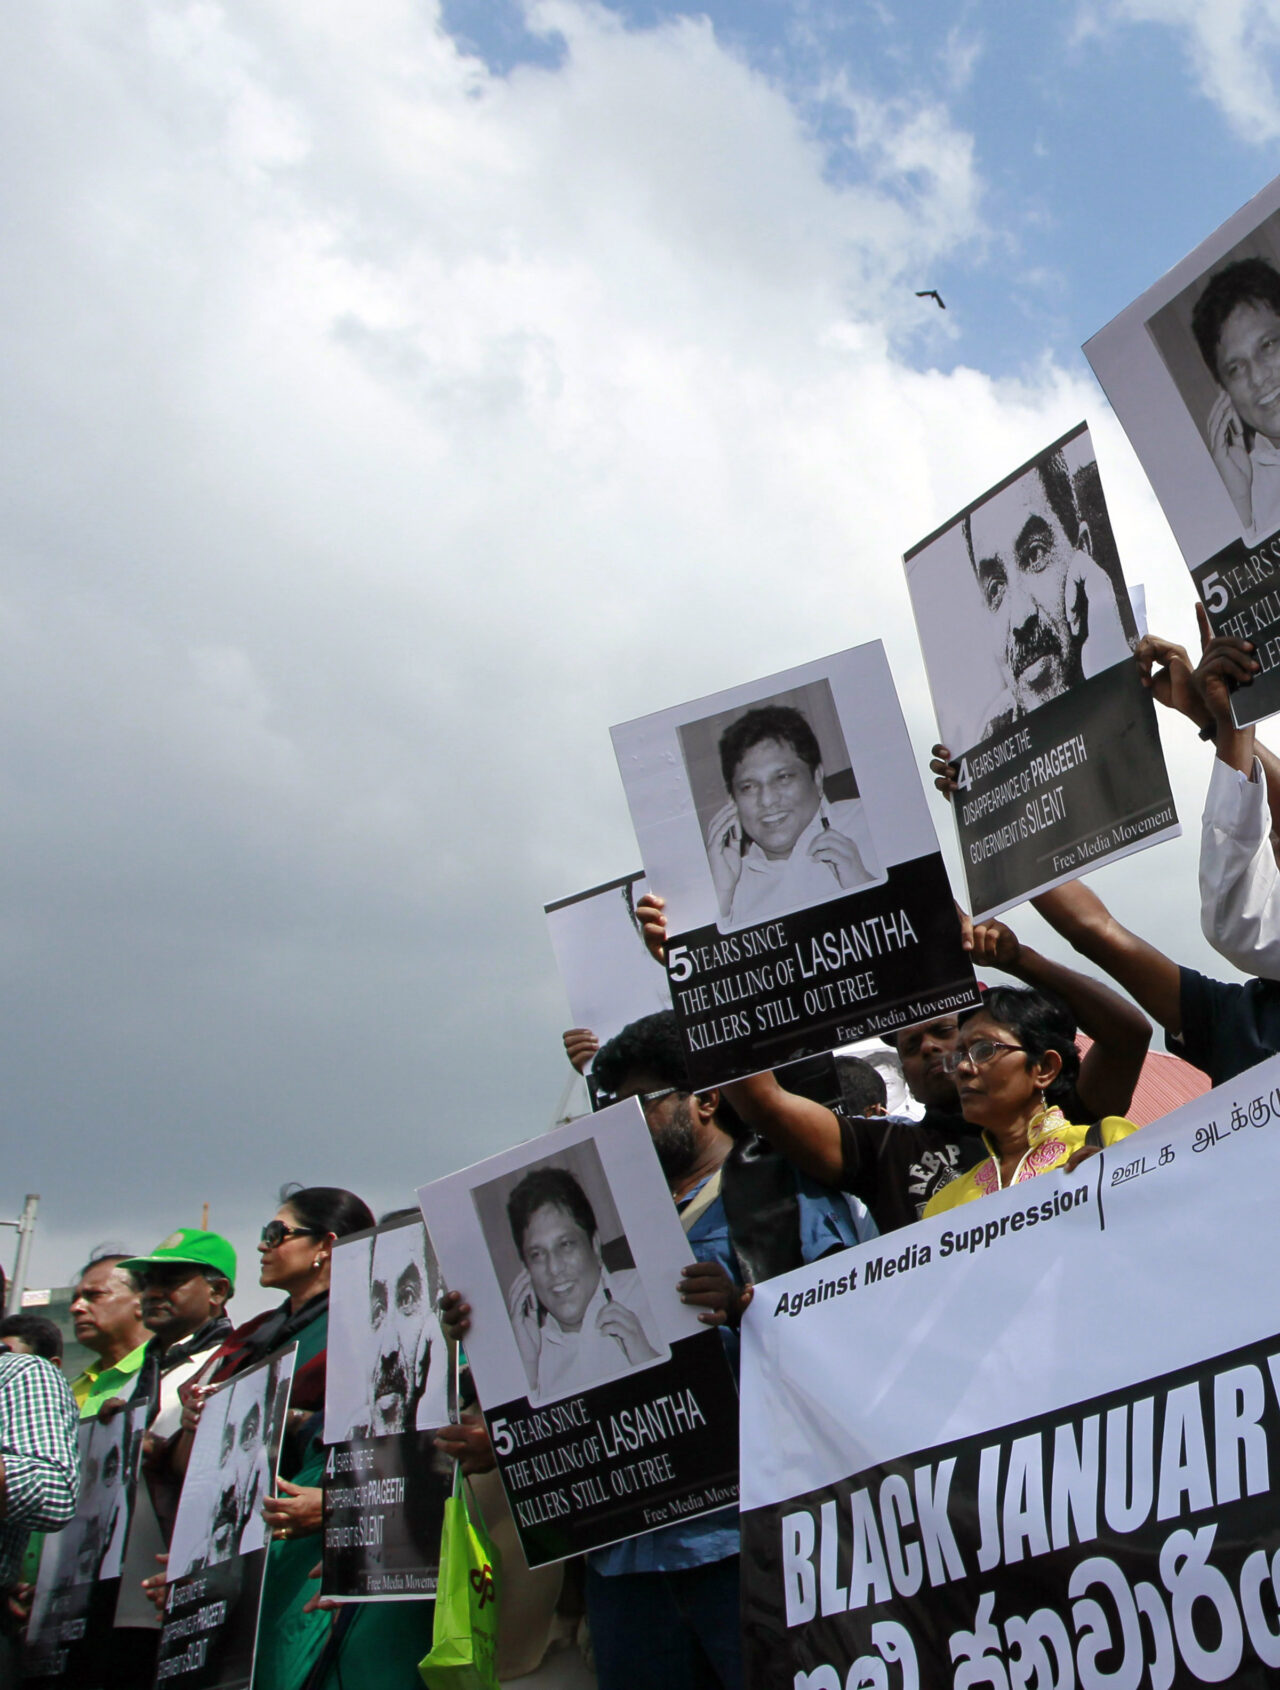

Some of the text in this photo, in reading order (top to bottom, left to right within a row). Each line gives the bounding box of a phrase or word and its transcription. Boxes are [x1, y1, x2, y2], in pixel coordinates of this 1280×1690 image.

[1222, 615, 1252, 638] THE
[963, 735, 1087, 825] DISAPPEARANCE OF PRAGEETH
[994, 742, 1016, 767] SINCE
[1016, 728, 1032, 752] THE
[970, 786, 1066, 864] GOVERNMENT IS SILENT
[1052, 806, 1173, 873] Free Media Movement
[678, 910, 918, 1015] THE KILLING OF LASANTHA
[742, 923, 787, 957] SINCE
[687, 972, 877, 1051] KILLERS STILL OUT FREE
[836, 987, 976, 1042] Free Media Movement
[774, 1186, 1087, 1316] Against Media Suppression
[505, 1389, 706, 1489] THE KILLING OF LASANTHA
[551, 1399, 589, 1432] SINCE
[368, 1476, 405, 1505] PRAGEETH
[517, 1454, 674, 1527] KILLERS STILL OUT FREE
[642, 1506, 668, 1525] Free
[669, 1491, 704, 1516] Media
[782, 1457, 966, 1627] BLACK
